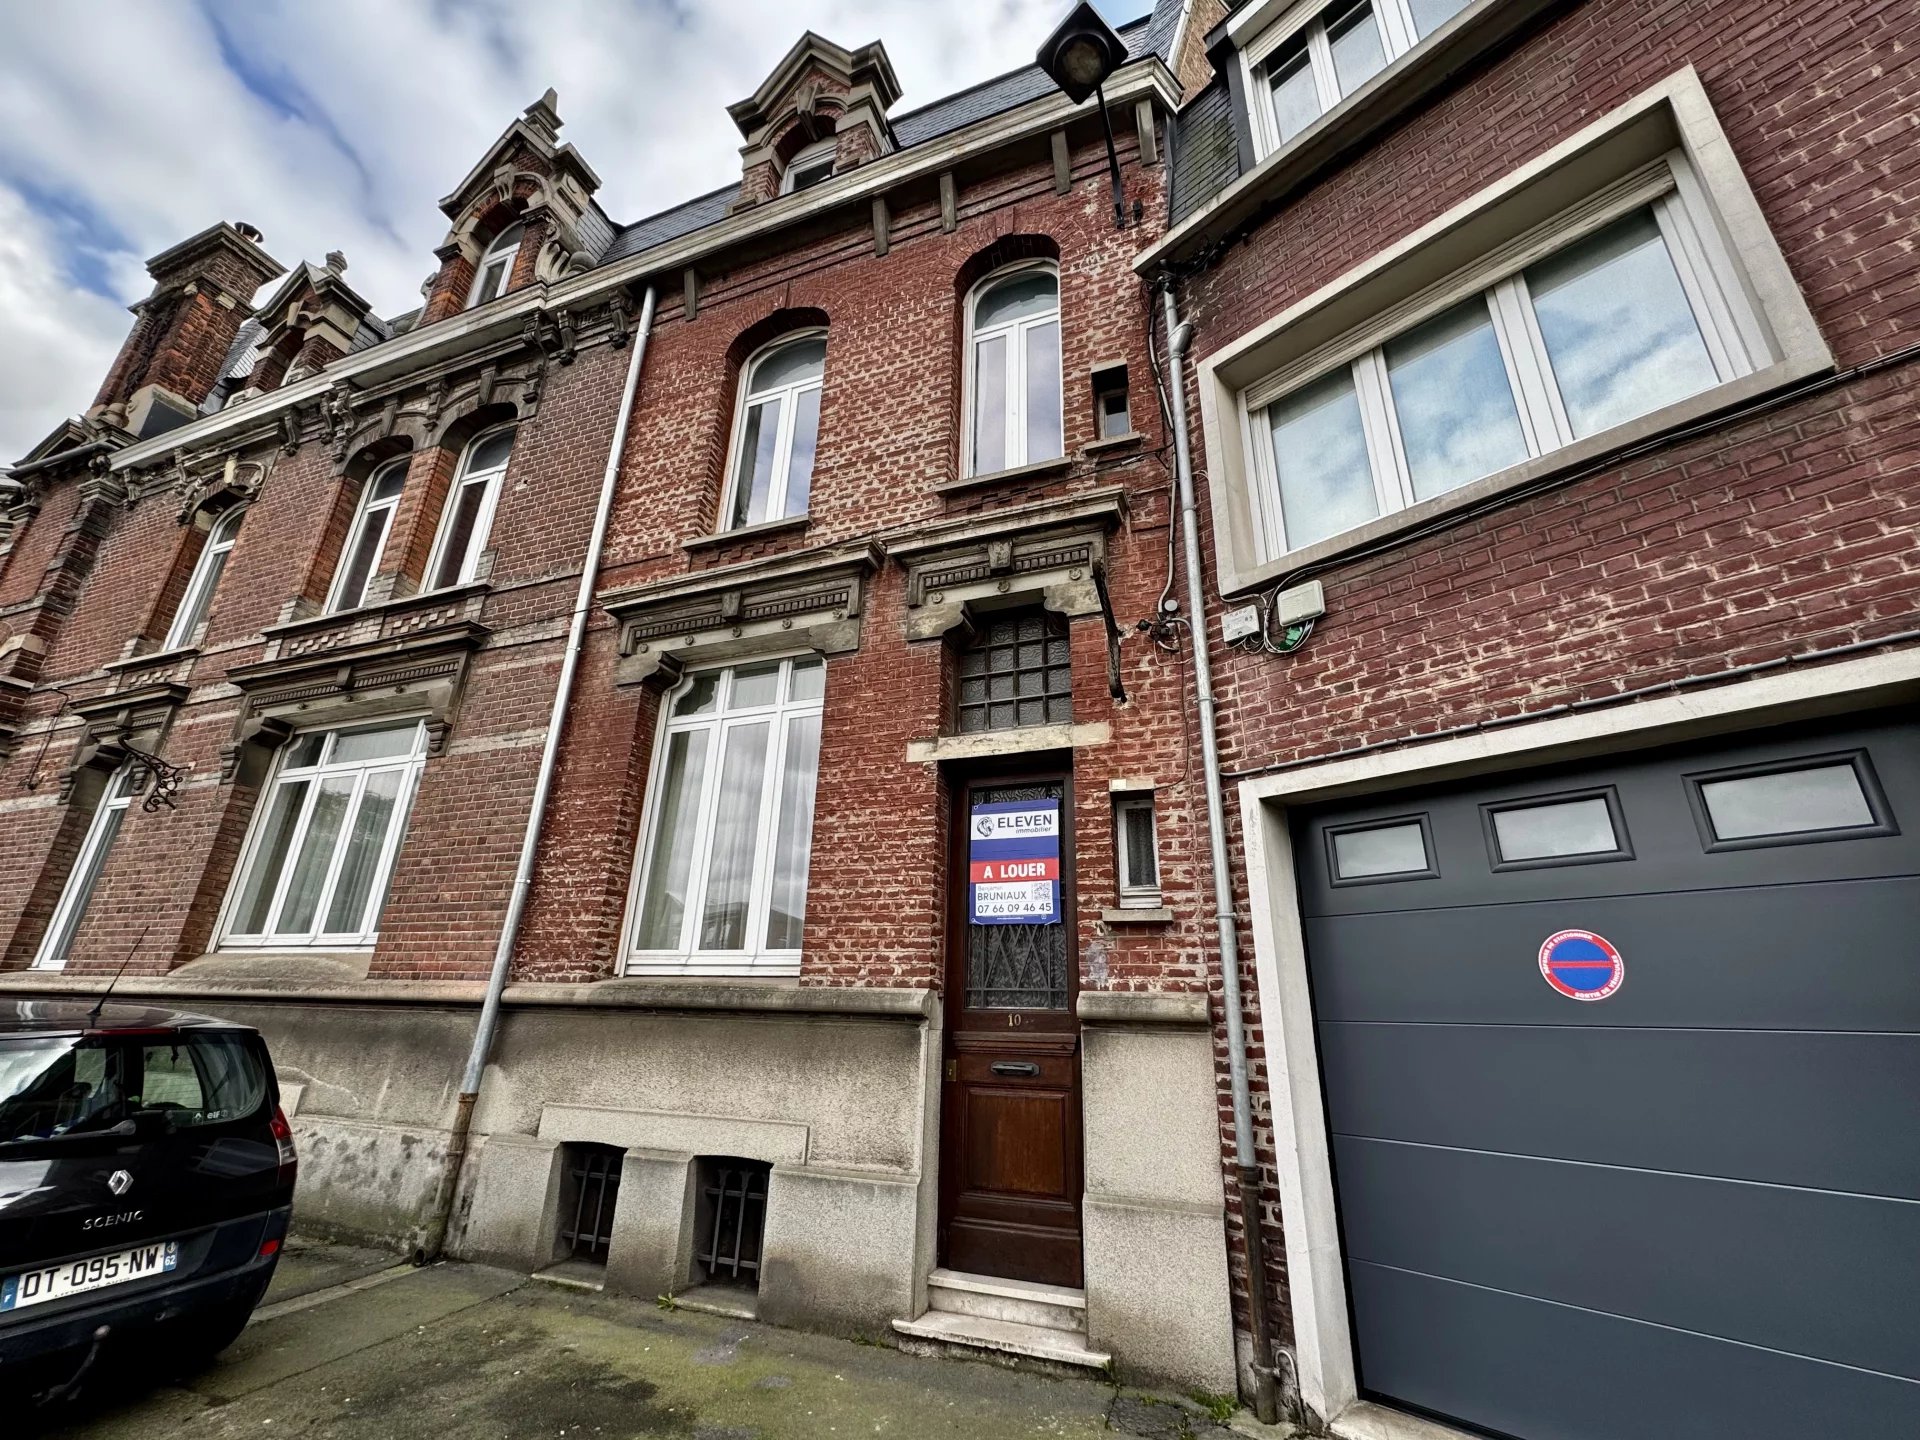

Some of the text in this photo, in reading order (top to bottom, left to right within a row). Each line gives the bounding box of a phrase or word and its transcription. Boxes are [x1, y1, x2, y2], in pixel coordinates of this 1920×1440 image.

[998, 814, 1052, 828] ELEVEN
[1016, 826, 1052, 834] immobilier
[983, 862, 1046, 878] A LOUER
[977, 891, 1027, 901] BRUNIAUX
[977, 902, 1052, 914] 07 66 09 46 45
[1008, 1013, 1021, 1026] 10
[82, 1210, 145, 1230] SCENIC
[164, 1255, 176, 1266] 62
[22, 1246, 160, 1299] DT-095-NW
[4, 1294, 12, 1304] F
